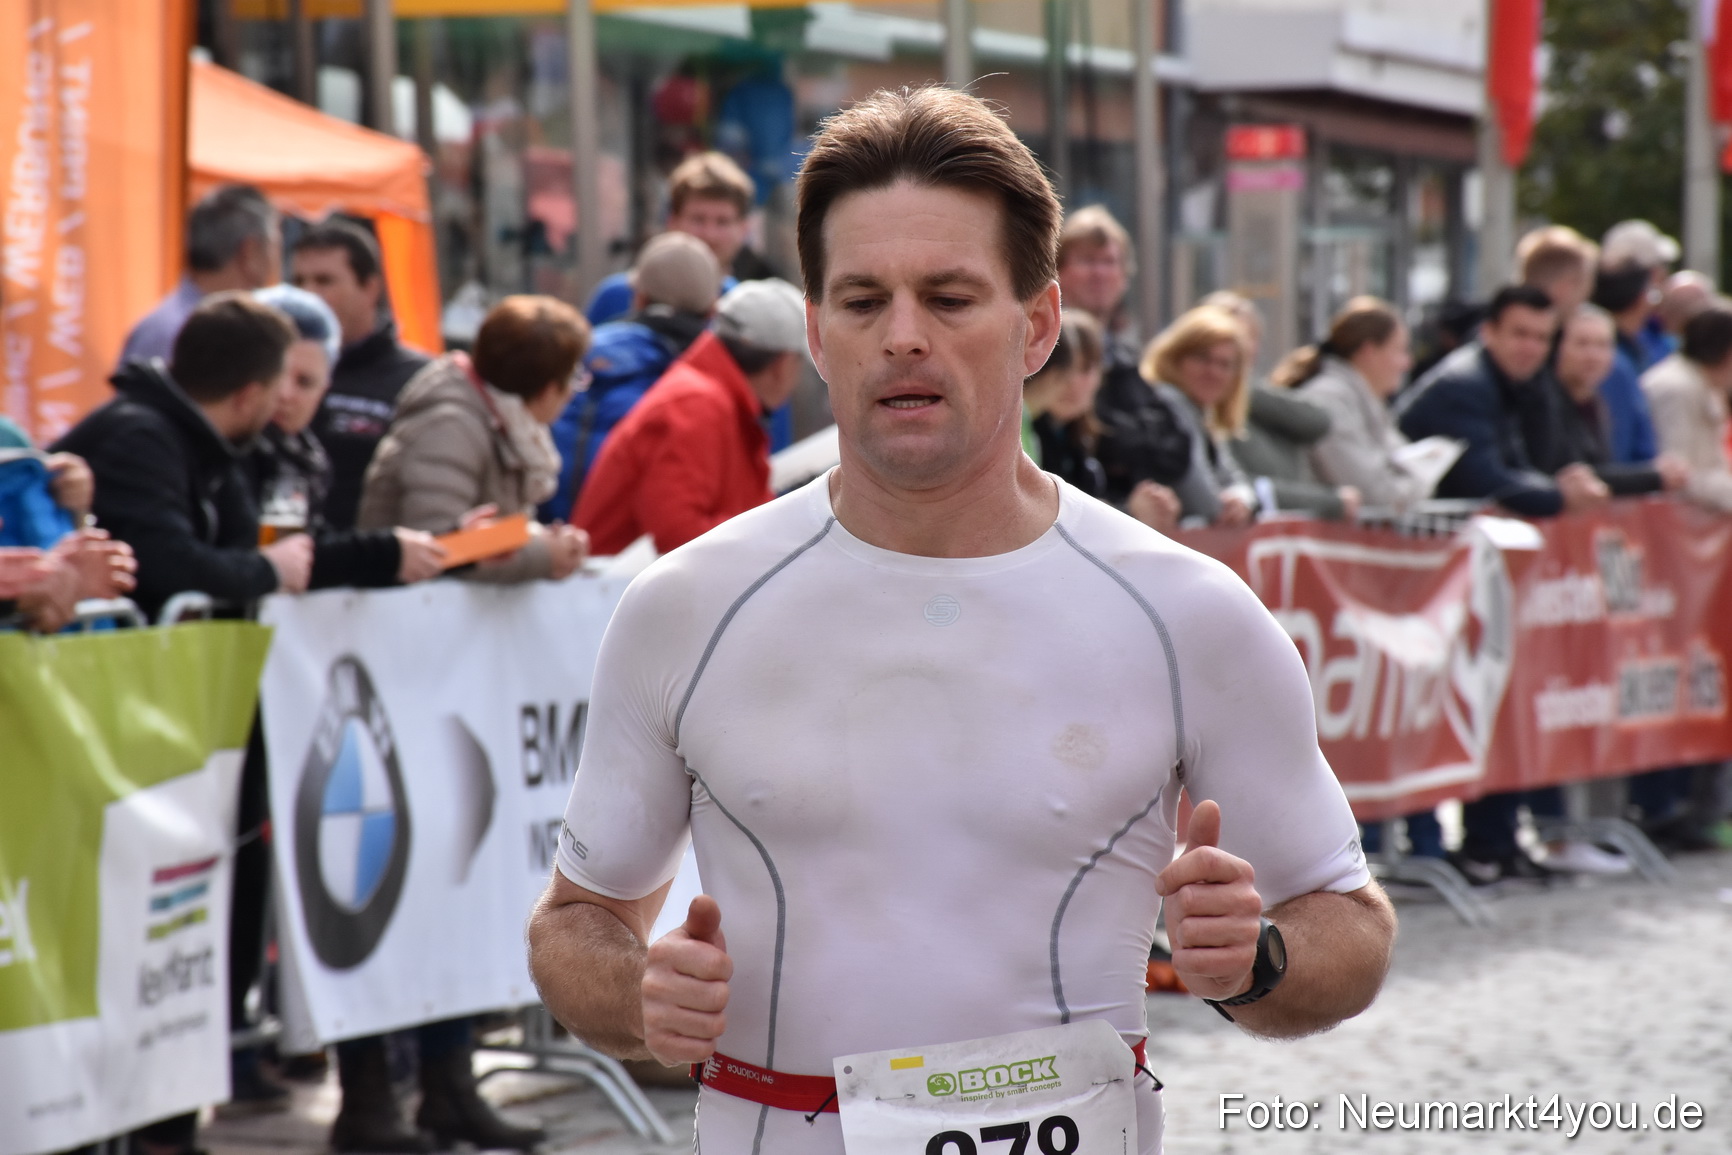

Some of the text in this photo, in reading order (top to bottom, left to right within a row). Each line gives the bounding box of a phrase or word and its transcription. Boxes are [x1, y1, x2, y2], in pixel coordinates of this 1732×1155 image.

[727, 1063, 760, 1083] balance
[958, 1056, 1059, 1094] BOCK
[960, 1080, 1062, 1103] inspired by smart concepts
